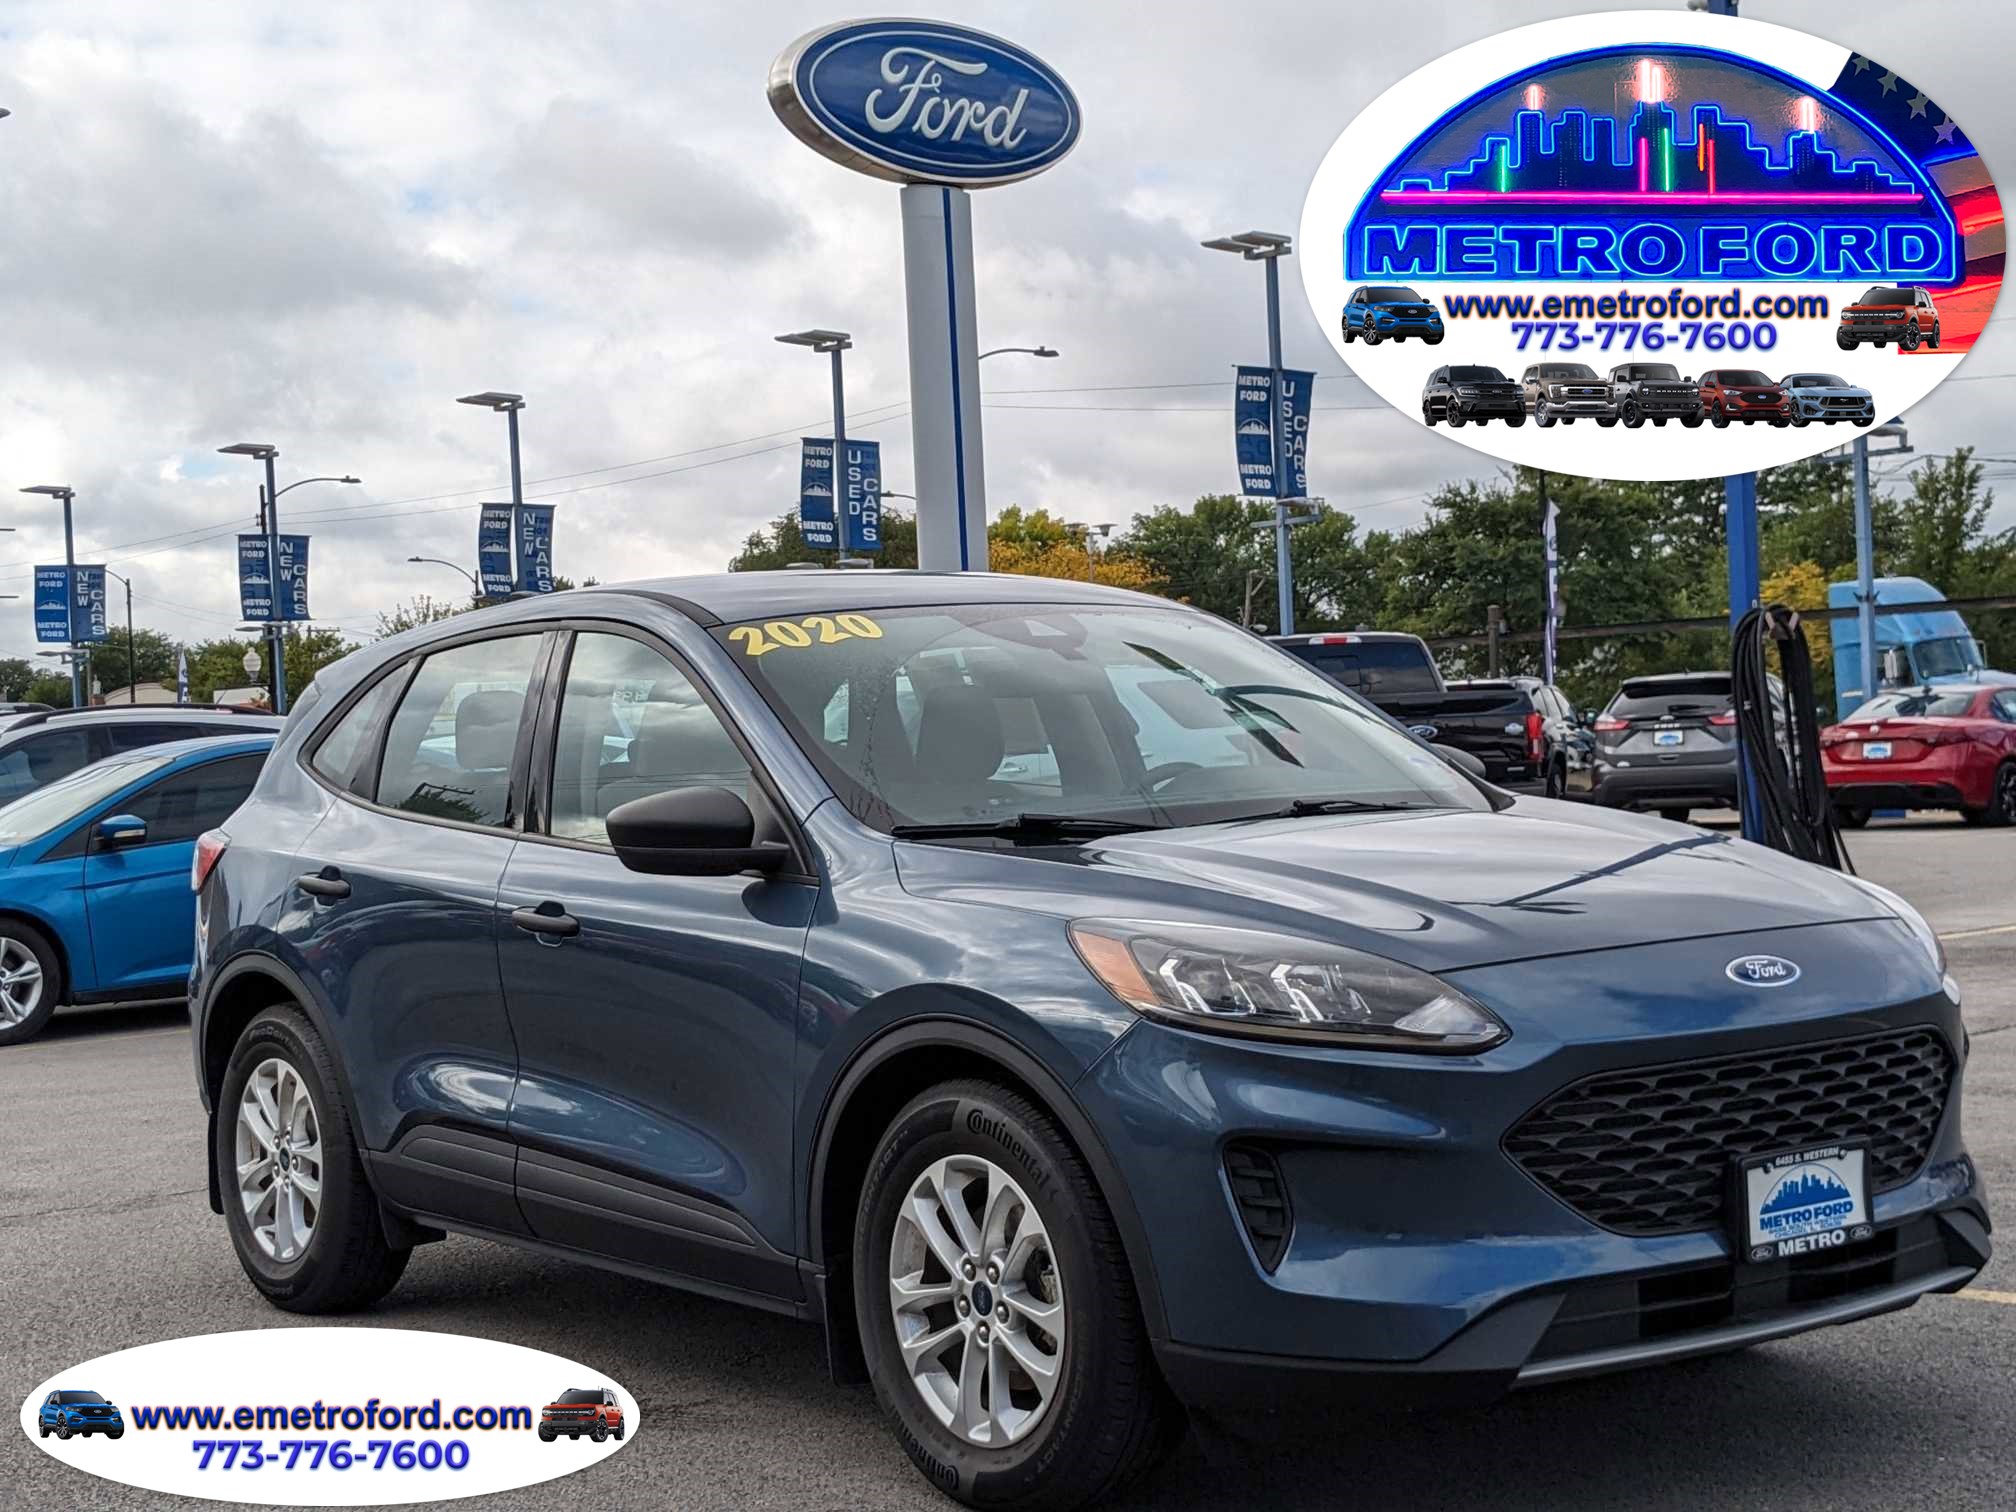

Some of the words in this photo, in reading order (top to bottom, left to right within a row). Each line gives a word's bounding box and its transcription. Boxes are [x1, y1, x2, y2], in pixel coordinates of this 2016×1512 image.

[865, 47, 1030, 150] Ford
[1238, 375, 1270, 387] METRO
[1240, 390, 1267, 401] FORD
[1282, 381, 1295, 457] USED
[803, 446, 832, 456] METRO
[805, 459, 830, 468] FORD
[1293, 416, 1307, 488] CARS
[847, 449, 861, 515] USED
[1240, 463, 1272, 475] METRO
[1244, 478, 1271, 489] FORD
[862, 478, 878, 541] CARS
[483, 521, 508, 529] FORD
[802, 521, 834, 531] METRO
[806, 533, 832, 543] FORD
[241, 550, 265, 558] FORD
[280, 542, 294, 581] NEW
[535, 536, 553, 592] CARS
[77, 571, 89, 606] NEW
[293, 564, 307, 614] CARS
[90, 590, 105, 635] CARS
[728, 614, 883, 656] 2020
[1745, 960, 1787, 979] Ford
[966, 1107, 1051, 1190] Continental
[1760, 1209, 1812, 1231] METRO
[1814, 1201, 1854, 1219] FORD
[1778, 1229, 1846, 1257] METRO
